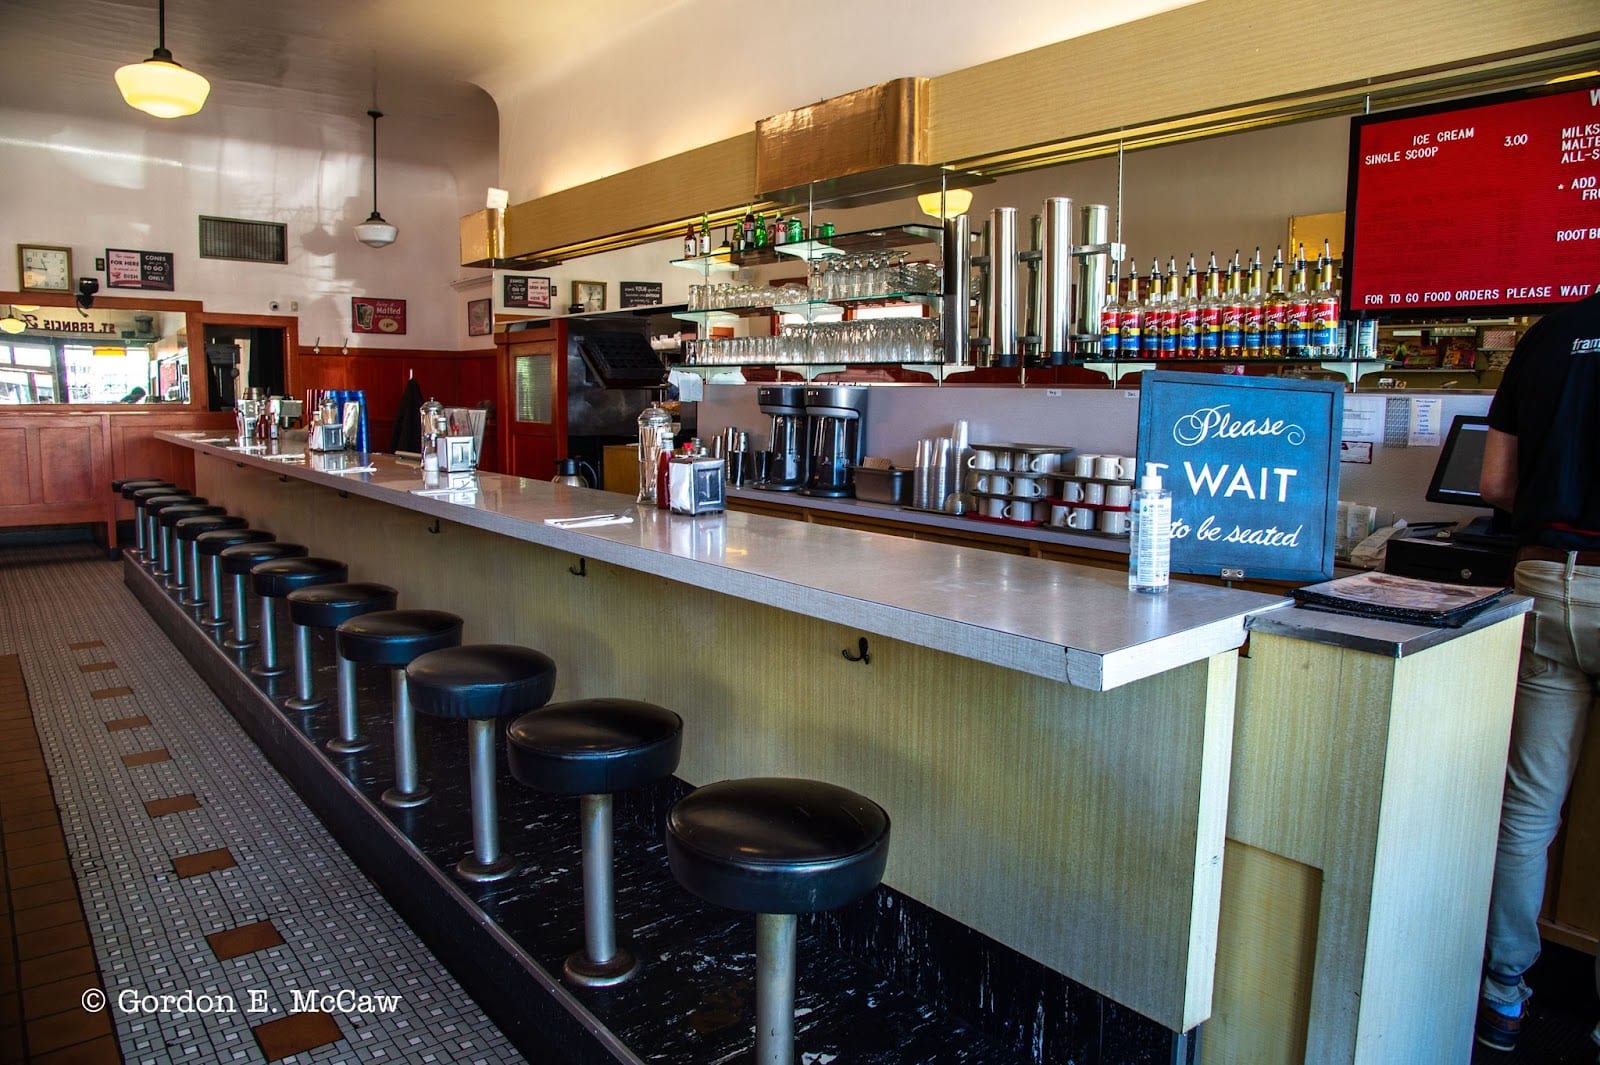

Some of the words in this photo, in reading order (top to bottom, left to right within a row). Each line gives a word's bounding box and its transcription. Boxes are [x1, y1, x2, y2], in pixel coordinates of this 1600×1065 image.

[1413, 133, 1430, 146] ICE
[1437, 127, 1475, 143] CREAM
[1562, 123, 1600, 139] MILKS
[1365, 150, 1401, 166] SINGLE
[1405, 146, 1439, 160] SCOOP
[1504, 133, 1528, 147] 3.00
[1561, 148, 1600, 164] ALL-S
[1571, 176, 1597, 190] ADD
[1556, 228, 1588, 242] ROOT
[153, 264, 164, 272] GO
[1365, 294, 1383, 305] FOR
[1390, 294, 1401, 304] TO
[1405, 293, 1419, 304] GO
[1424, 291, 1451, 303] FOOD
[1455, 289, 1500, 301] ORDERS
[1506, 286, 1552, 299] PLEASE
[1560, 284, 1591, 297] WAIT
[376, 307, 401, 315] Malted
[1173, 404, 1306, 447] Please
[1183, 461, 1298, 503] WAIT
[1169, 517, 1192, 540] to
[1197, 515, 1222, 541] be
[1223, 524, 1303, 548] seated
